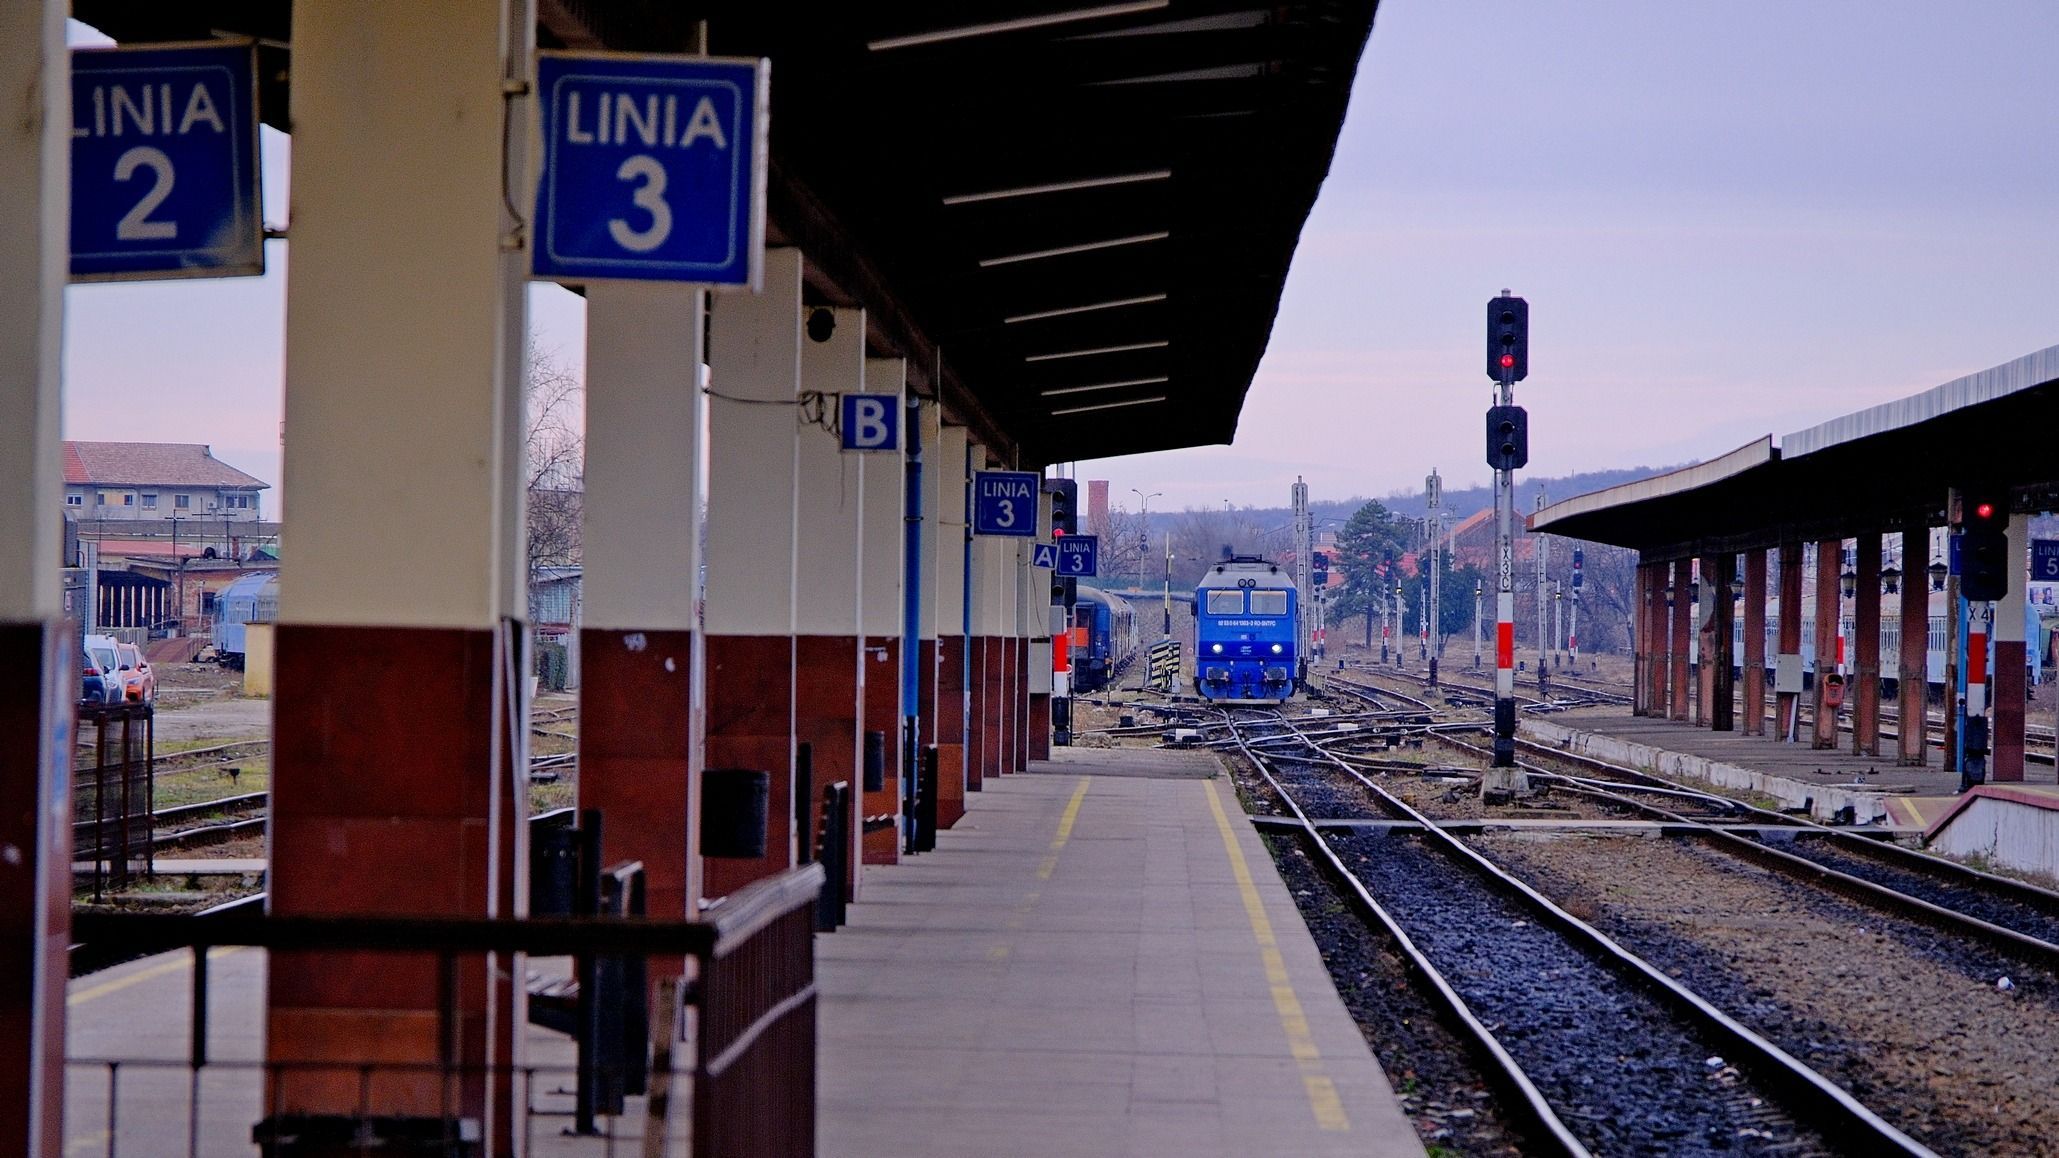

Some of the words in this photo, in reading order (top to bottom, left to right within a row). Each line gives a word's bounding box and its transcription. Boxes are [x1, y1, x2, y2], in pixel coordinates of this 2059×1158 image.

[567, 91, 727, 148] LINIA
[113, 145, 178, 240] 2
[608, 154, 673, 252] 3
[855, 398, 888, 447] B
[983, 481, 1031, 498] LINIA
[996, 499, 1015, 528] 3
[1034, 546, 1054, 568] A
[1063, 542, 1091, 553] LINIA
[1071, 554, 1083, 572] 3
[2046, 557, 2058, 575] 5
